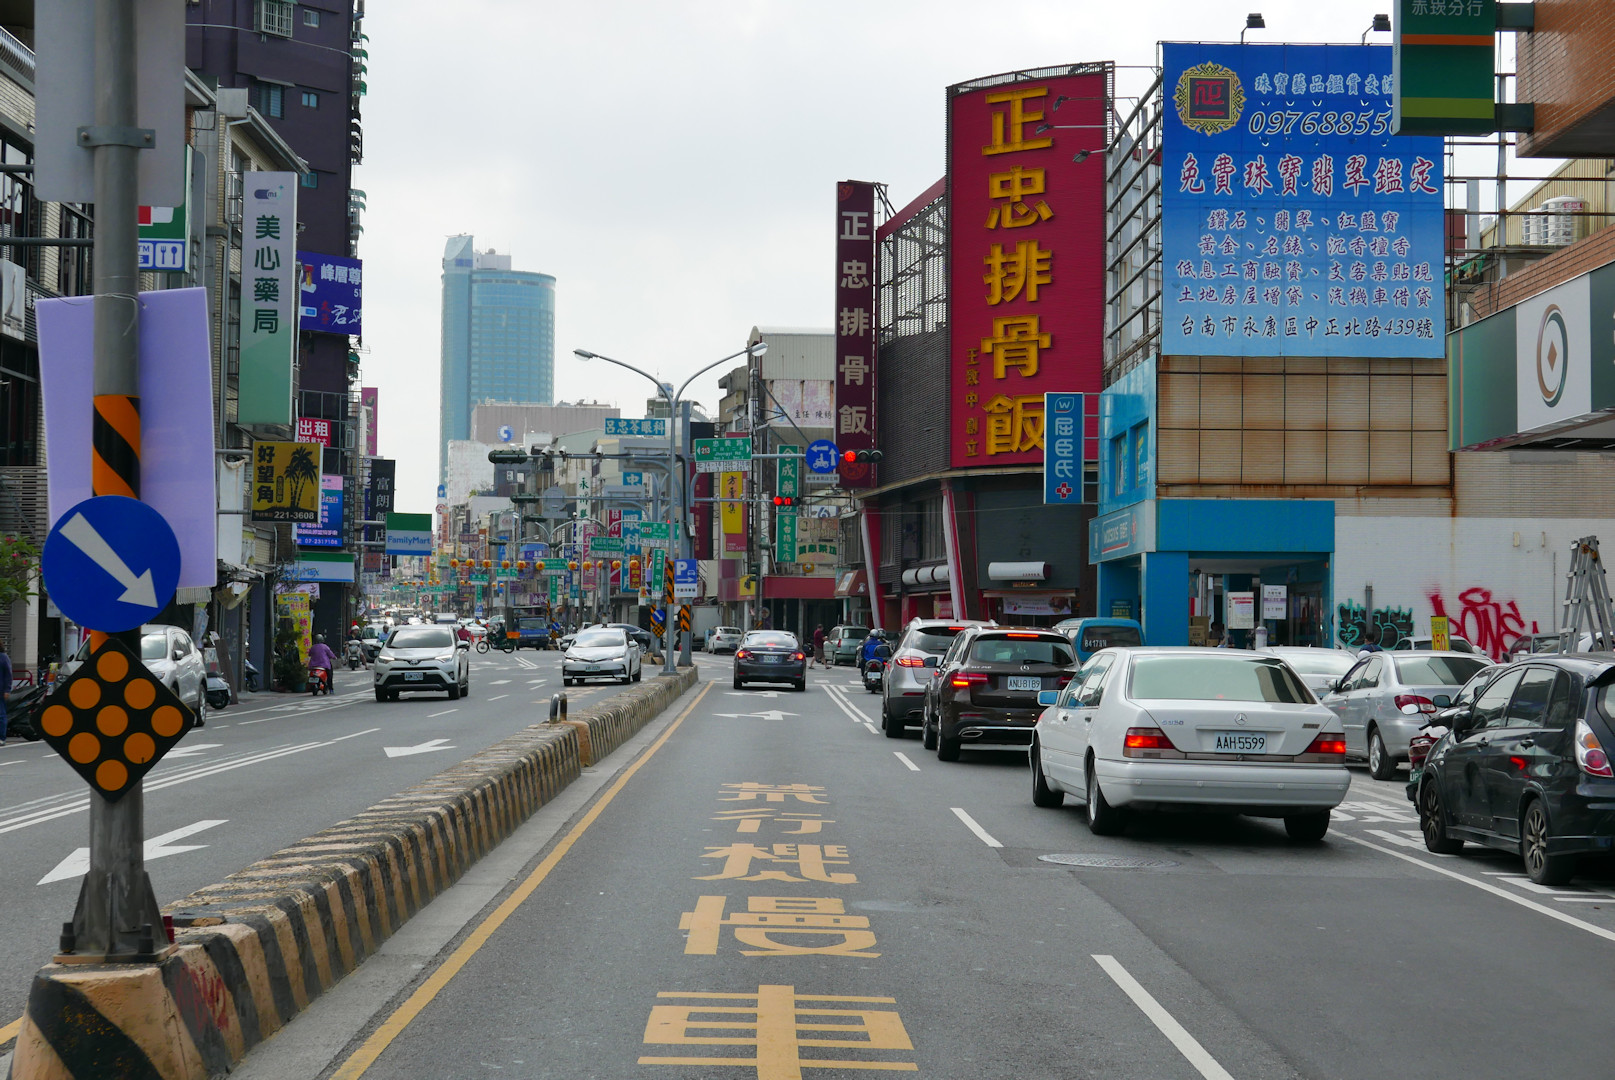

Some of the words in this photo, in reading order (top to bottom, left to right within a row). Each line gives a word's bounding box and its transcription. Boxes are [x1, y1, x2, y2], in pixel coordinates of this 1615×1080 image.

[1412, 0, 1483, 16] 赤崁分行
[1249, 109, 1394, 135] 09768855
[1179, 153, 1438, 198] 免費珠寶翡翠鑑定
[1207, 210, 1400, 232] 鑽石、翡翠、紅藍寶
[1198, 236, 1411, 256] 黃金、名錶、沉香檀香
[253, 215, 280, 334] 美心藥局
[980, 85, 1053, 456] 正忠排骨飯
[1177, 261, 1433, 282] 低息工商融資、支客票貼現
[1177, 286, 1433, 308] 土地房屋增貸、汽機車借貸
[839, 211, 870, 435] 正忠排骨飯
[1180, 315, 1434, 339] 台南市永康區中正北路439號
[300, 420, 328, 437] 出租
[257, 445, 275, 503] 好望角
[274, 511, 314, 519] 221-3608
[388, 536, 430, 545] FamilyMart
[677, 561, 688, 576] P
